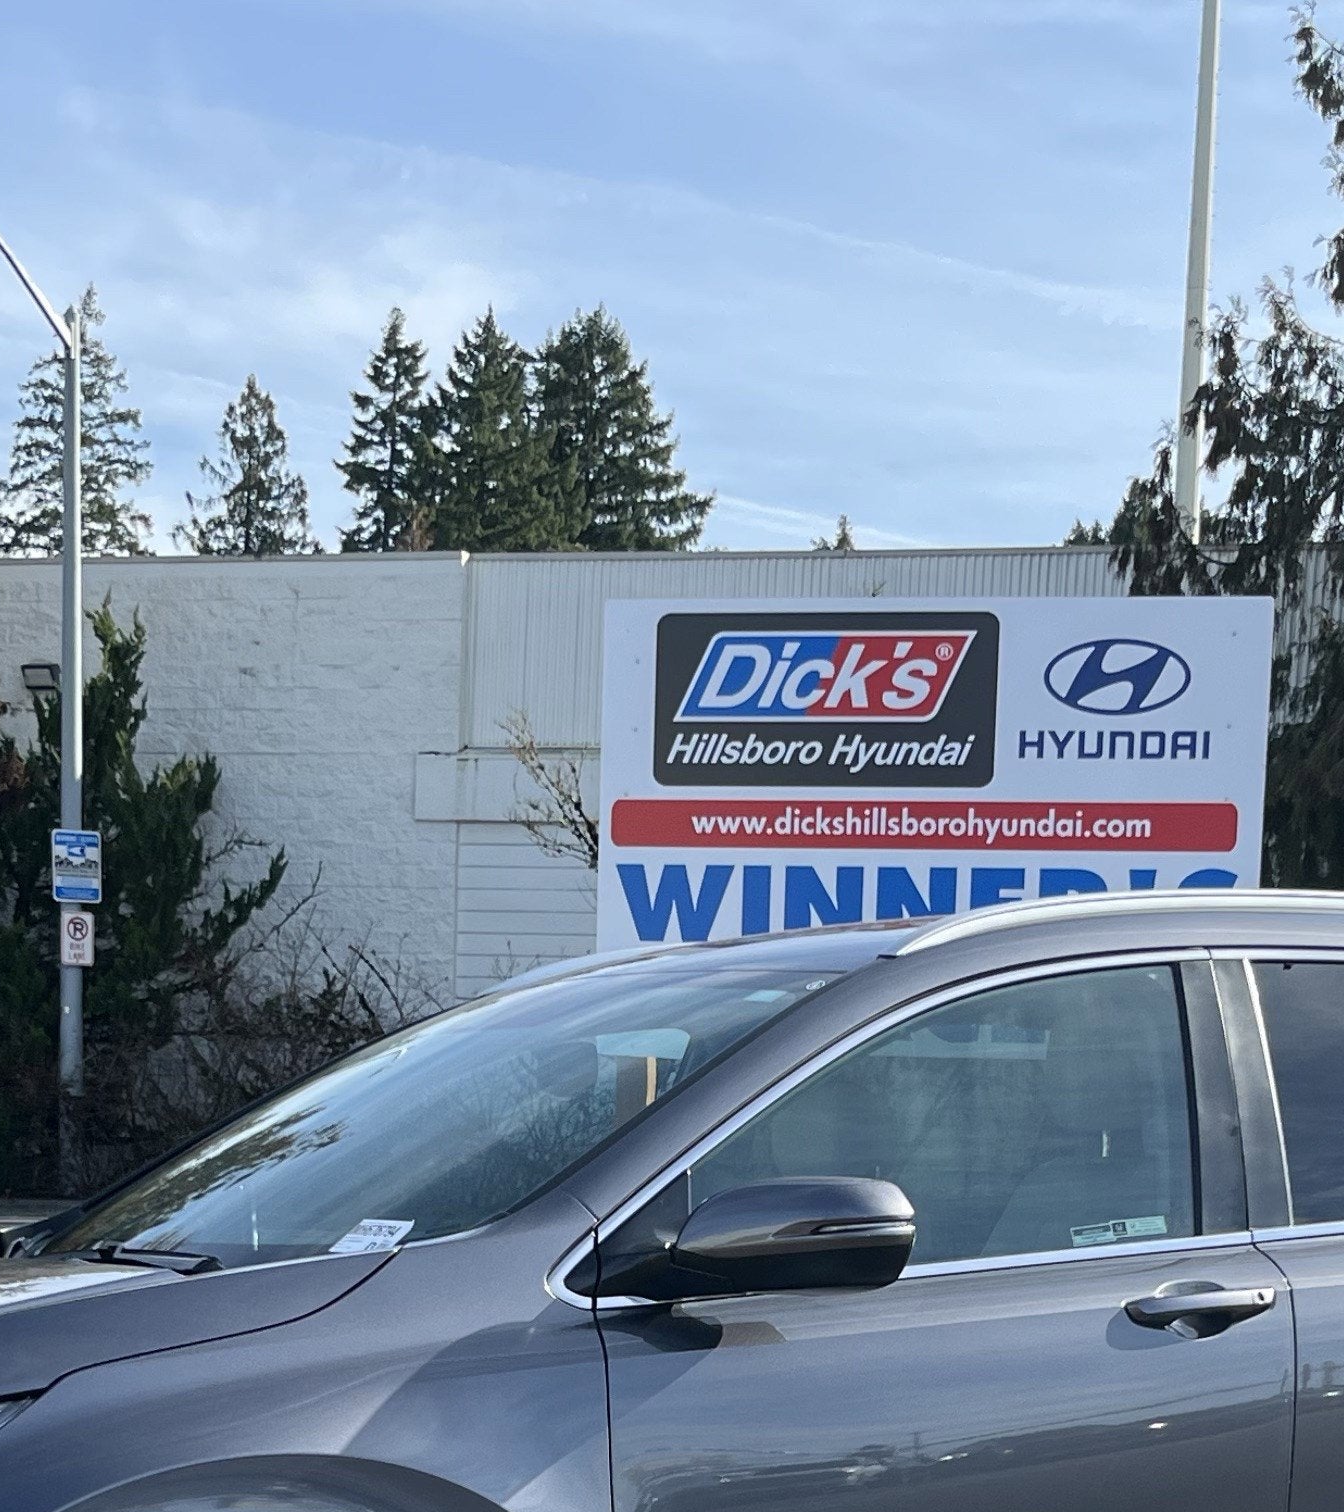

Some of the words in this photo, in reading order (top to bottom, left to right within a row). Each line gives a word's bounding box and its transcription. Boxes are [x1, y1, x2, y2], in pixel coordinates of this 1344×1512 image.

[666, 733, 823, 764] Hillsboro
[828, 733, 976, 774] Hyundai
[1017, 730, 1211, 760] HYUNDAI
[691, 806, 1152, 844] www.dickshillsborohyundai.com
